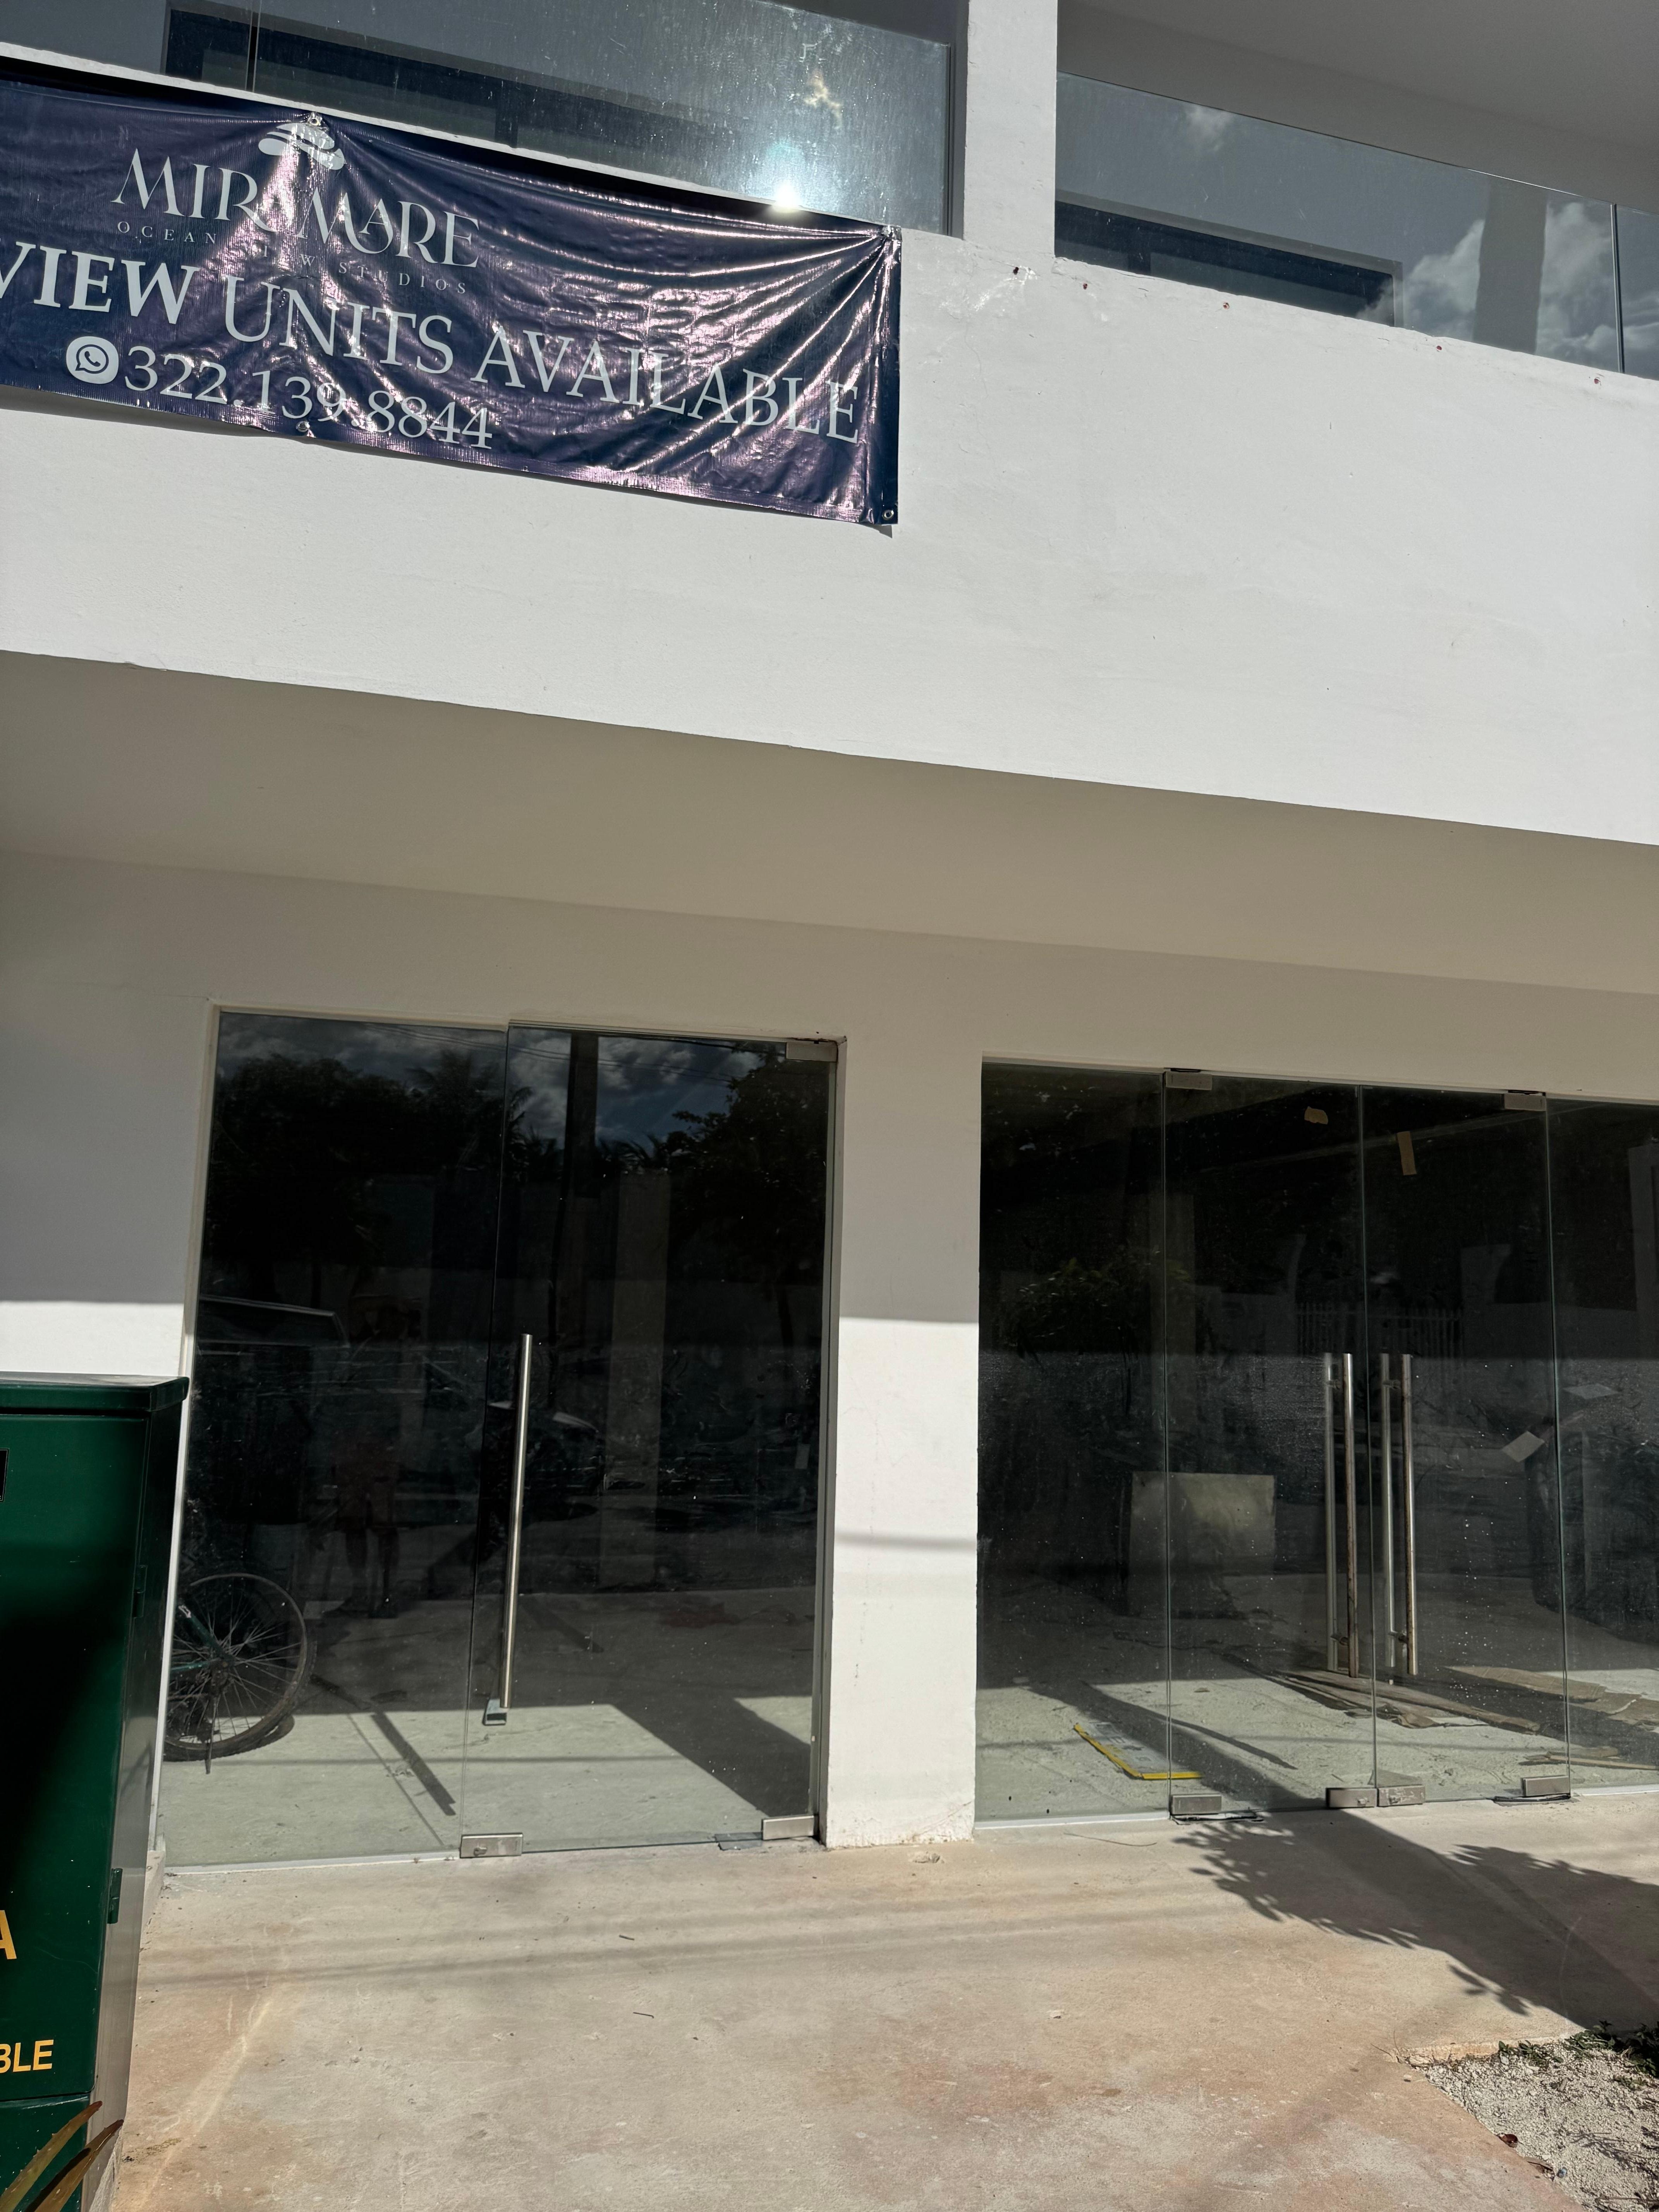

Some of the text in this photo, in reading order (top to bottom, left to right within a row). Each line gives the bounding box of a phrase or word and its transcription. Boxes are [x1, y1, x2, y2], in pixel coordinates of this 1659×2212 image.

[117, 221, 216, 244] OCEAN
[338, 262, 465, 294] STUDIOS
[0, 238, 858, 443] VIEW UNITS AVAILABLE
[125, 346, 492, 449] 322.139.8844
